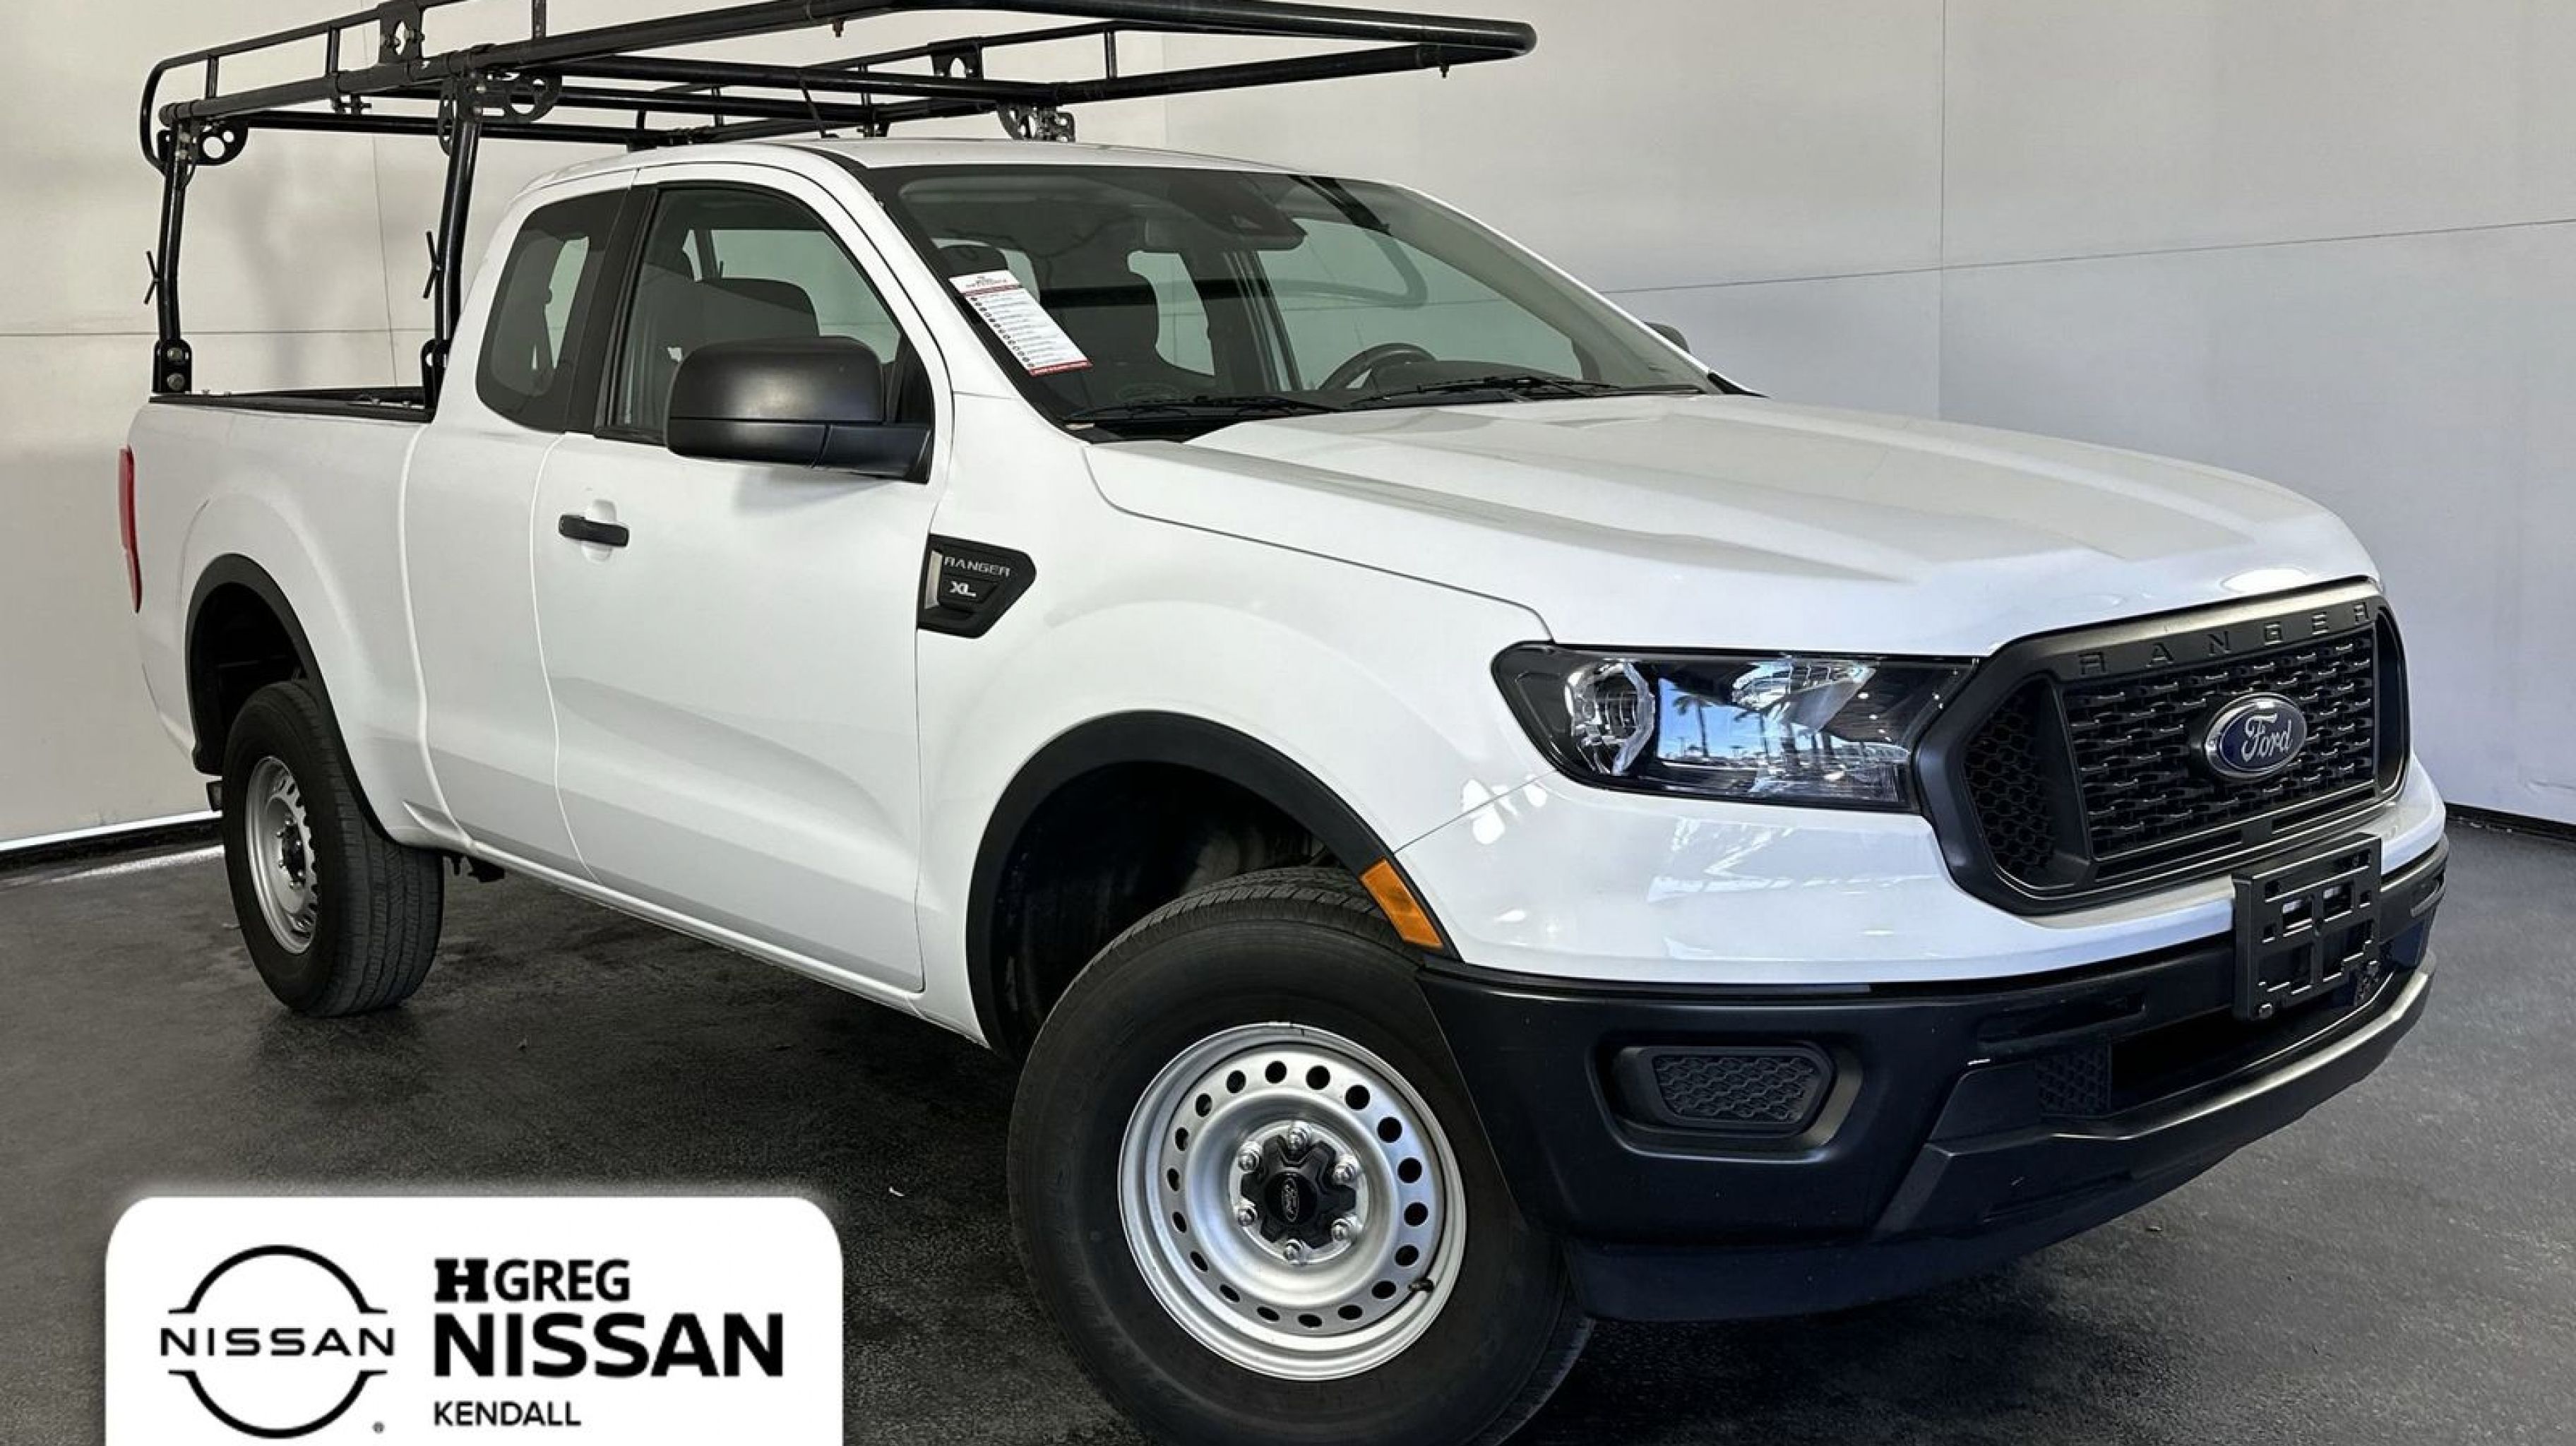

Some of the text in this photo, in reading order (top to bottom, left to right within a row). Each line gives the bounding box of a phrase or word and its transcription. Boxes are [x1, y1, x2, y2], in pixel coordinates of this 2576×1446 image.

[944, 556, 1010, 578] RANGER
[949, 580, 977, 598] XL
[2079, 601, 2371, 676] RANGER
[2241, 712, 2293, 762] Ford
